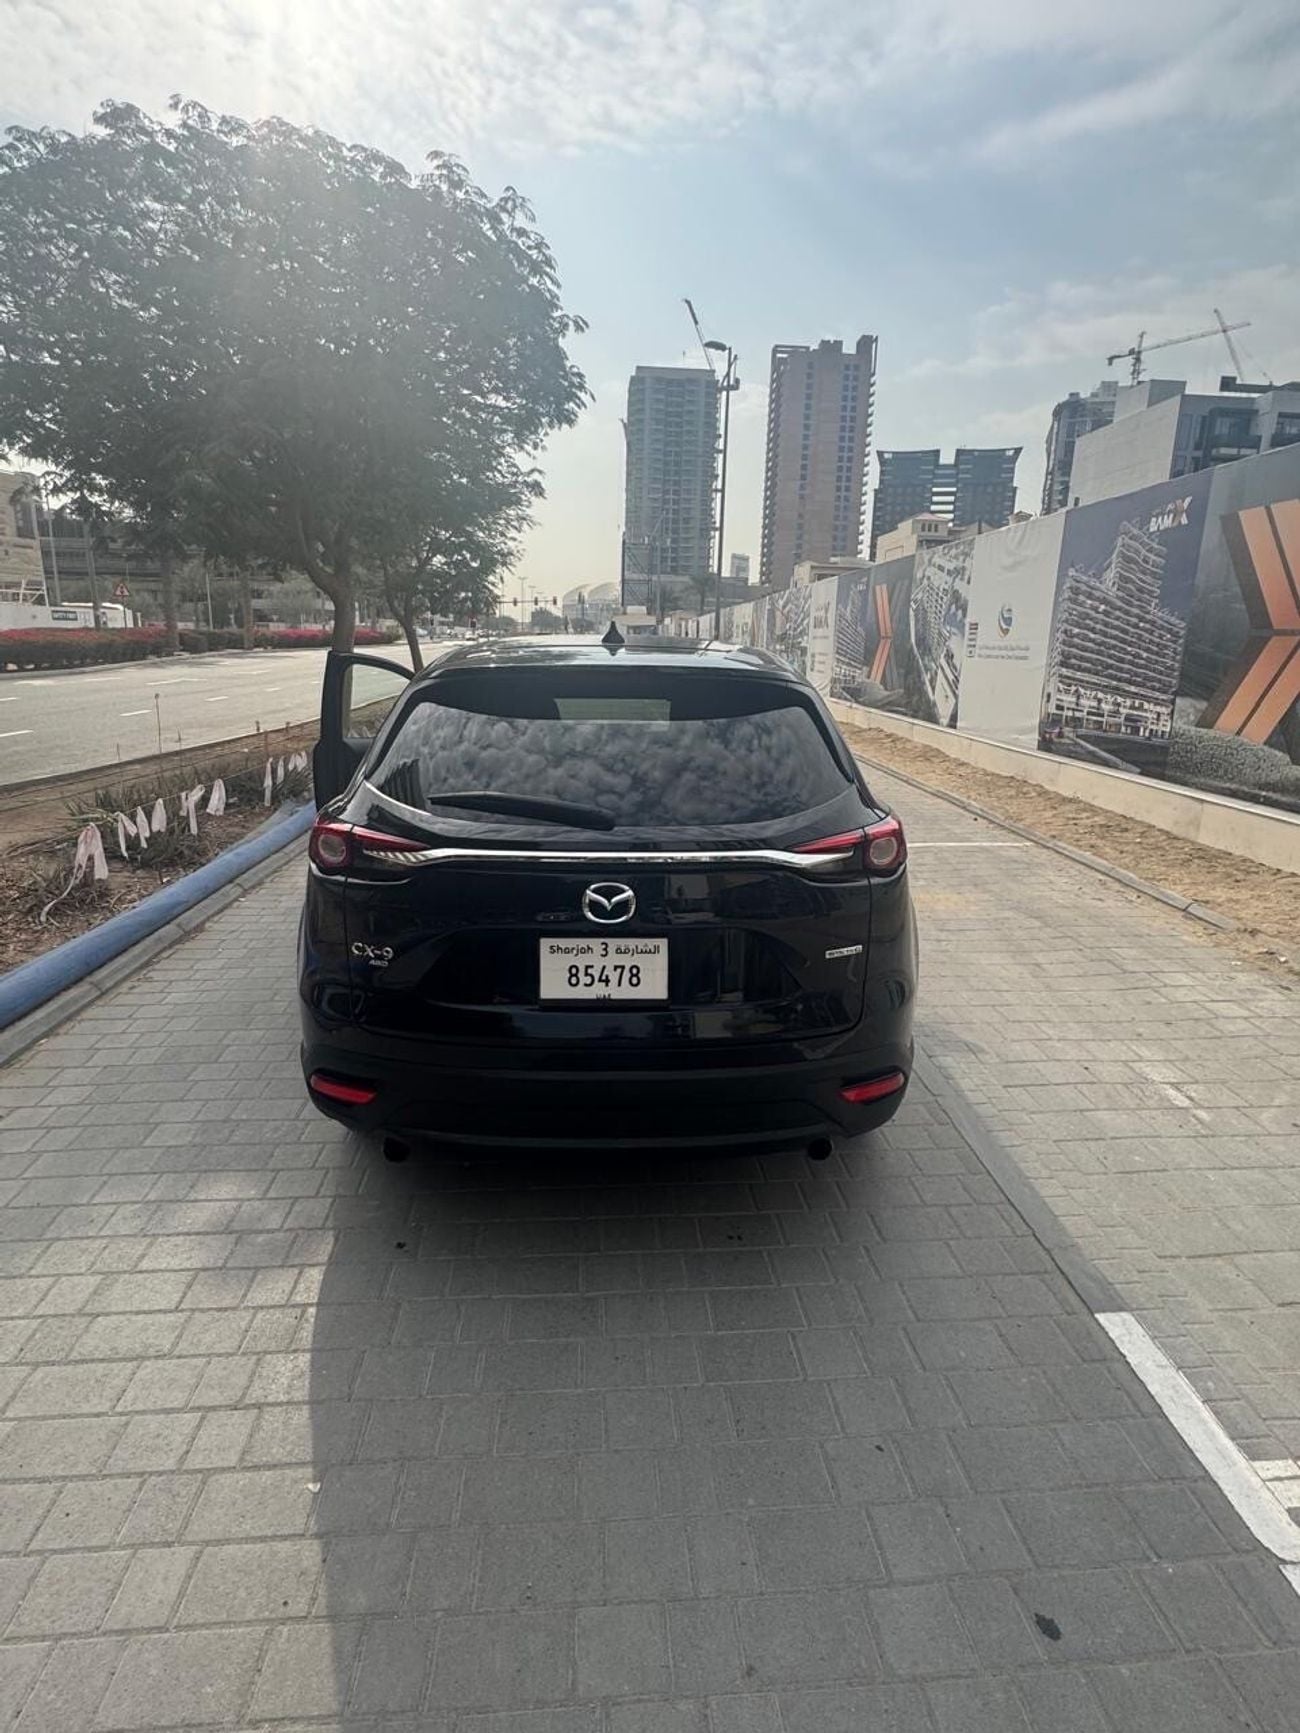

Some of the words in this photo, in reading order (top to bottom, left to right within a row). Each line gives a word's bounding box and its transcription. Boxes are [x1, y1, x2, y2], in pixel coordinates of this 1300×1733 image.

[351, 942, 394, 960] CX-9
[549, 944, 594, 957] Sharjah
[600, 942, 609, 957] 3
[615, 943, 660, 956] الشارقة
[568, 965, 641, 987] 85478
